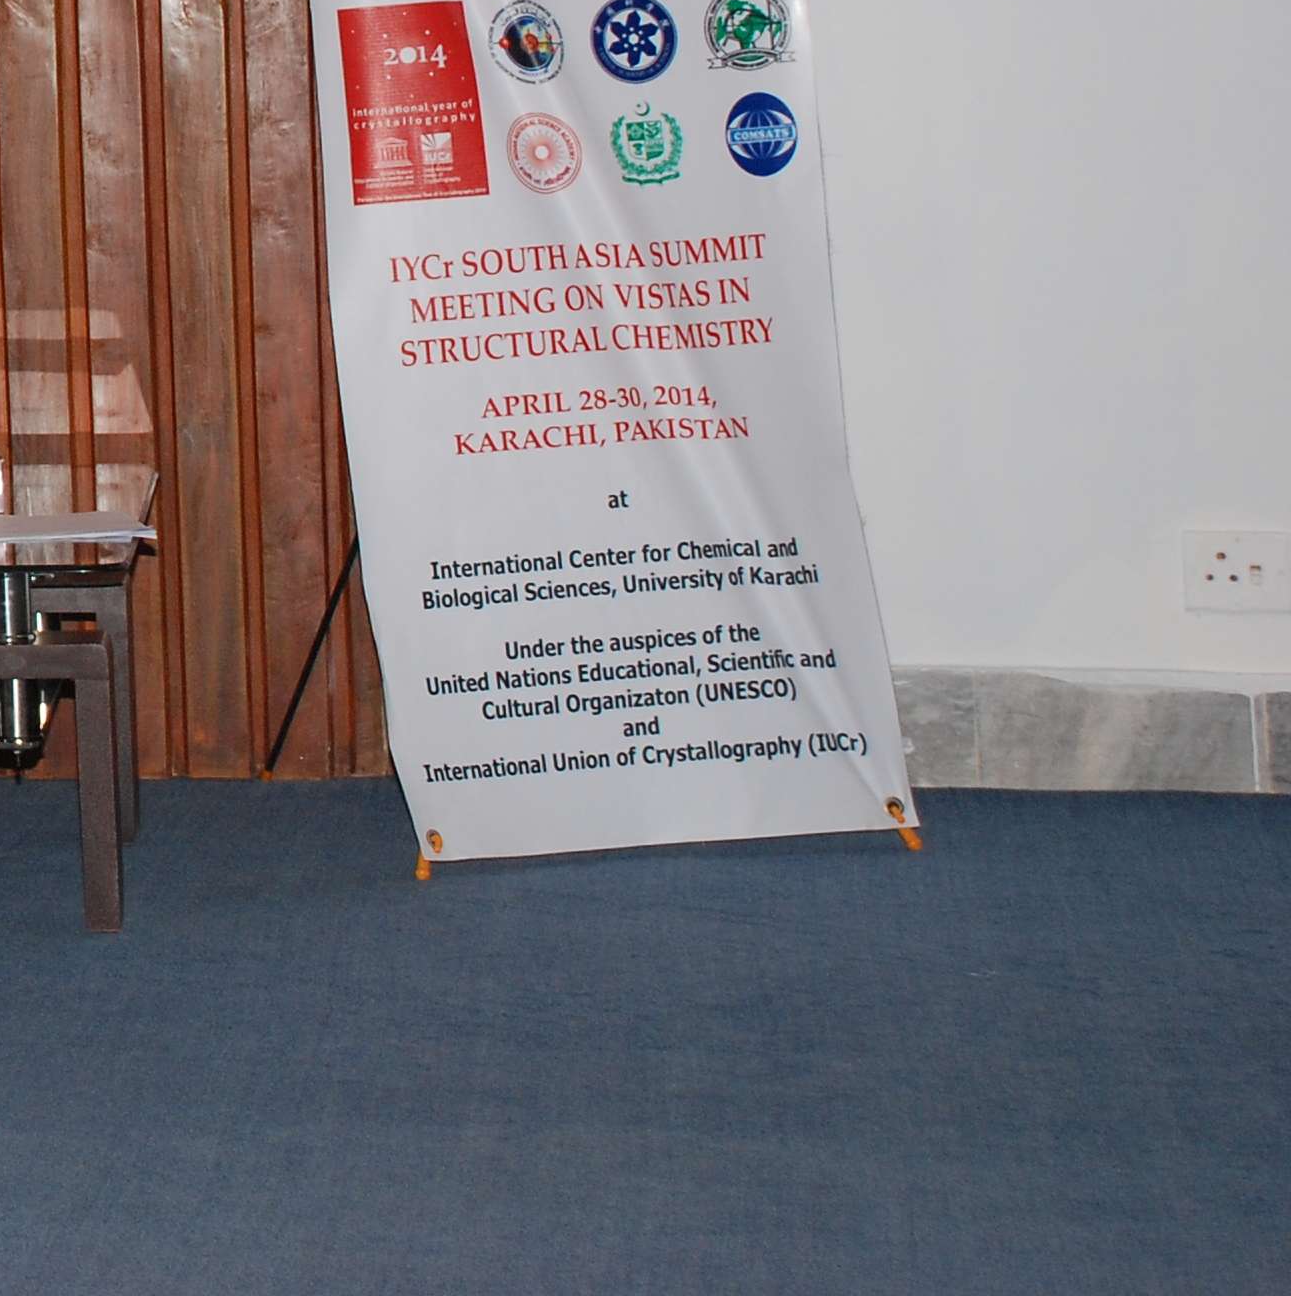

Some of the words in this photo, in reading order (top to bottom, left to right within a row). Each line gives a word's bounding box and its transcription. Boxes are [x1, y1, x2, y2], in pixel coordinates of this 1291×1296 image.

[383, 44, 448, 68] 2014
[353, 102, 429, 117] international
[432, 101, 457, 113] year
[461, 99, 473, 108] of
[353, 111, 476, 130] crystallography
[733, 126, 789, 141] COMSATS
[390, 254, 454, 283] IYCr
[462, 244, 569, 277] SOUTH
[575, 242, 646, 268] ASIA
[649, 233, 766, 268] SUMMIT
[410, 287, 555, 323] MEETING
[564, 284, 604, 311] ON
[613, 280, 710, 309] VISTAS
[718, 277, 750, 304] IN
[401, 326, 608, 367] STRUCTURAL
[611, 317, 773, 350] CHEMISTRY
[481, 392, 571, 418] APRIL
[578, 386, 647, 411] 28-30,
[653, 385, 717, 409] 2014,
[454, 423, 606, 455] KARACHI,
[614, 416, 749, 442] PAKISTAN
[607, 490, 629, 509] at
[430, 551, 563, 580] International
[569, 547, 635, 569] Center
[641, 544, 671, 563] for
[677, 539, 761, 560] Chemical
[767, 537, 798, 558] and
[422, 584, 519, 610] Biological
[525, 580, 617, 601] Sciences,
[623, 569, 723, 593] University
[728, 567, 744, 586] of
[750, 564, 819, 586] Karachi
[505, 638, 565, 660] Under
[571, 635, 604, 655] the
[610, 629, 696, 653] auspices
[702, 625, 722, 644] of
[729, 623, 761, 643] the
[426, 672, 490, 696] United
[496, 668, 572, 689] Nations
[577, 655, 702, 683] Educational,
[707, 649, 795, 673] Scientific
[800, 649, 836, 669] and
[482, 695, 560, 720] Cultural
[696, 677, 797, 707] (UNESCO)
[623, 716, 660, 737] and
[423, 754, 547, 783] International
[553, 750, 610, 772] Union
[616, 746, 636, 767] of
[642, 735, 802, 767] Crystallography
[809, 732, 867, 758] (IUCr)
